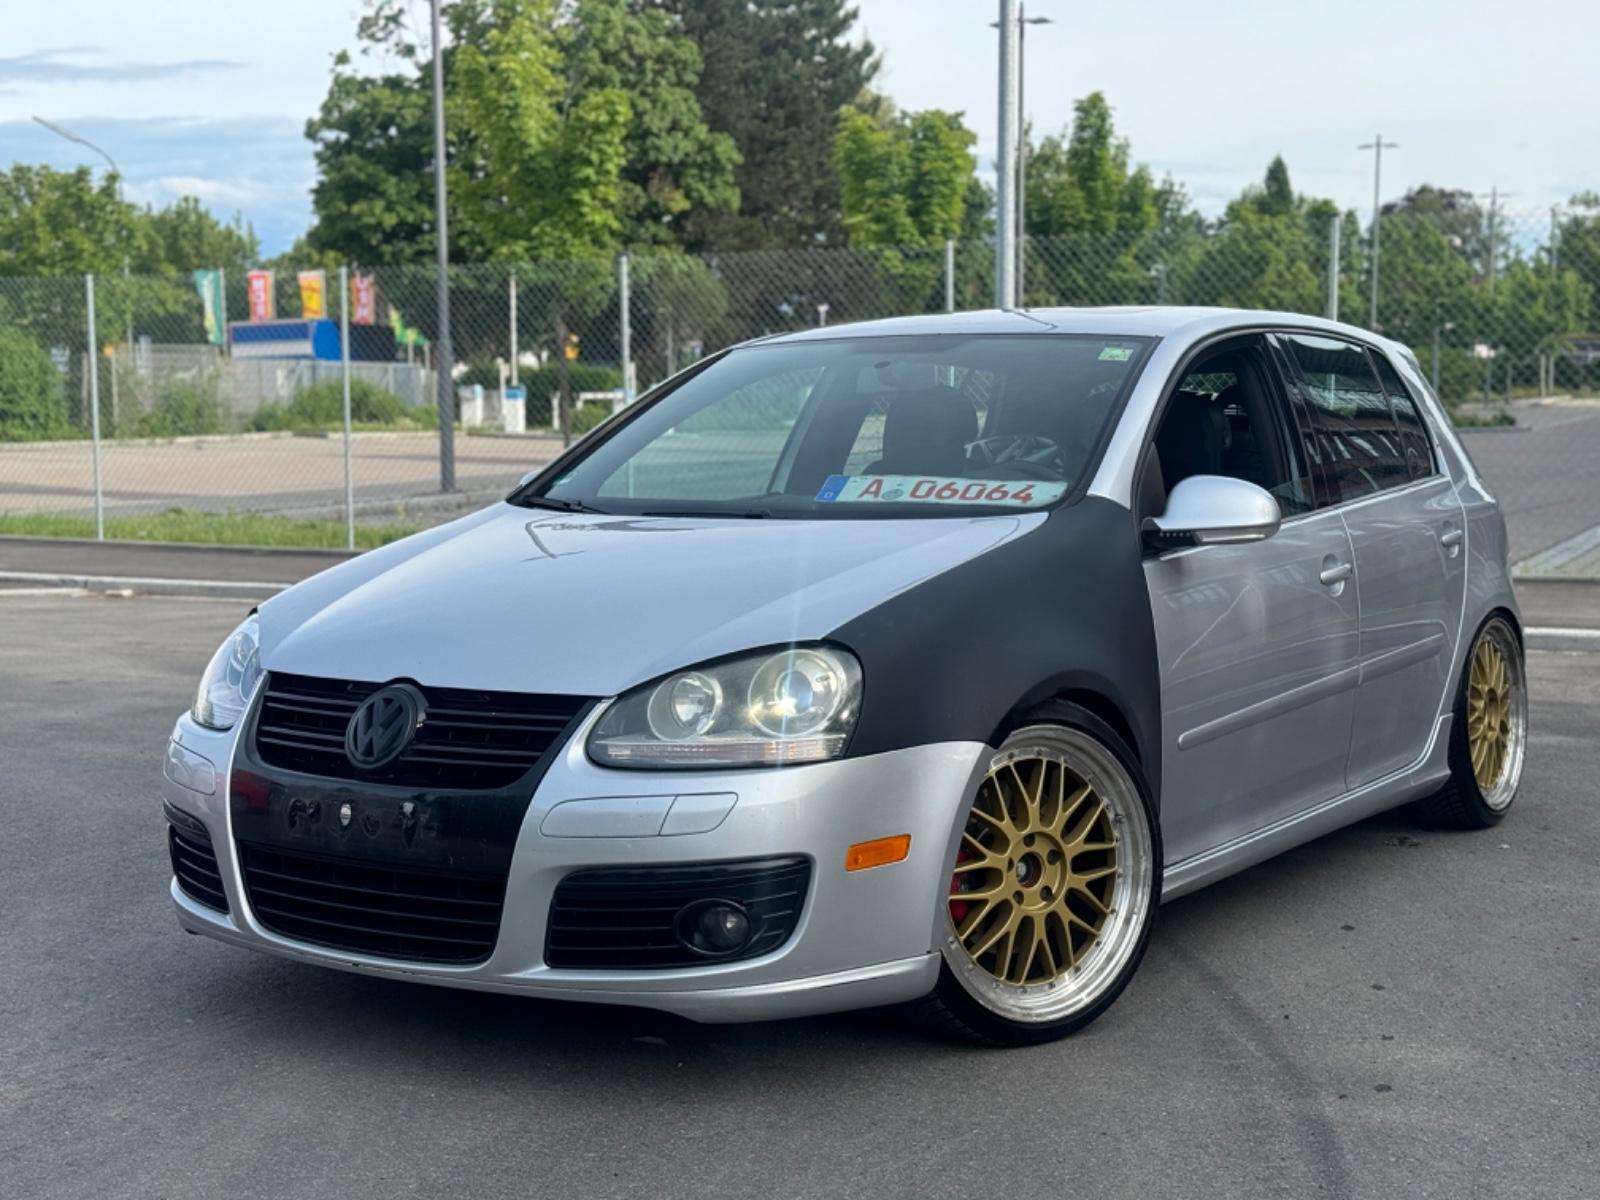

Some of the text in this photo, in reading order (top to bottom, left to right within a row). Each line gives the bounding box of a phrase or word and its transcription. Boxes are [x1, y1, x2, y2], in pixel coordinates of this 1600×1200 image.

[858, 478, 1037, 504] A 06064
[346, 684, 418, 768] VW
